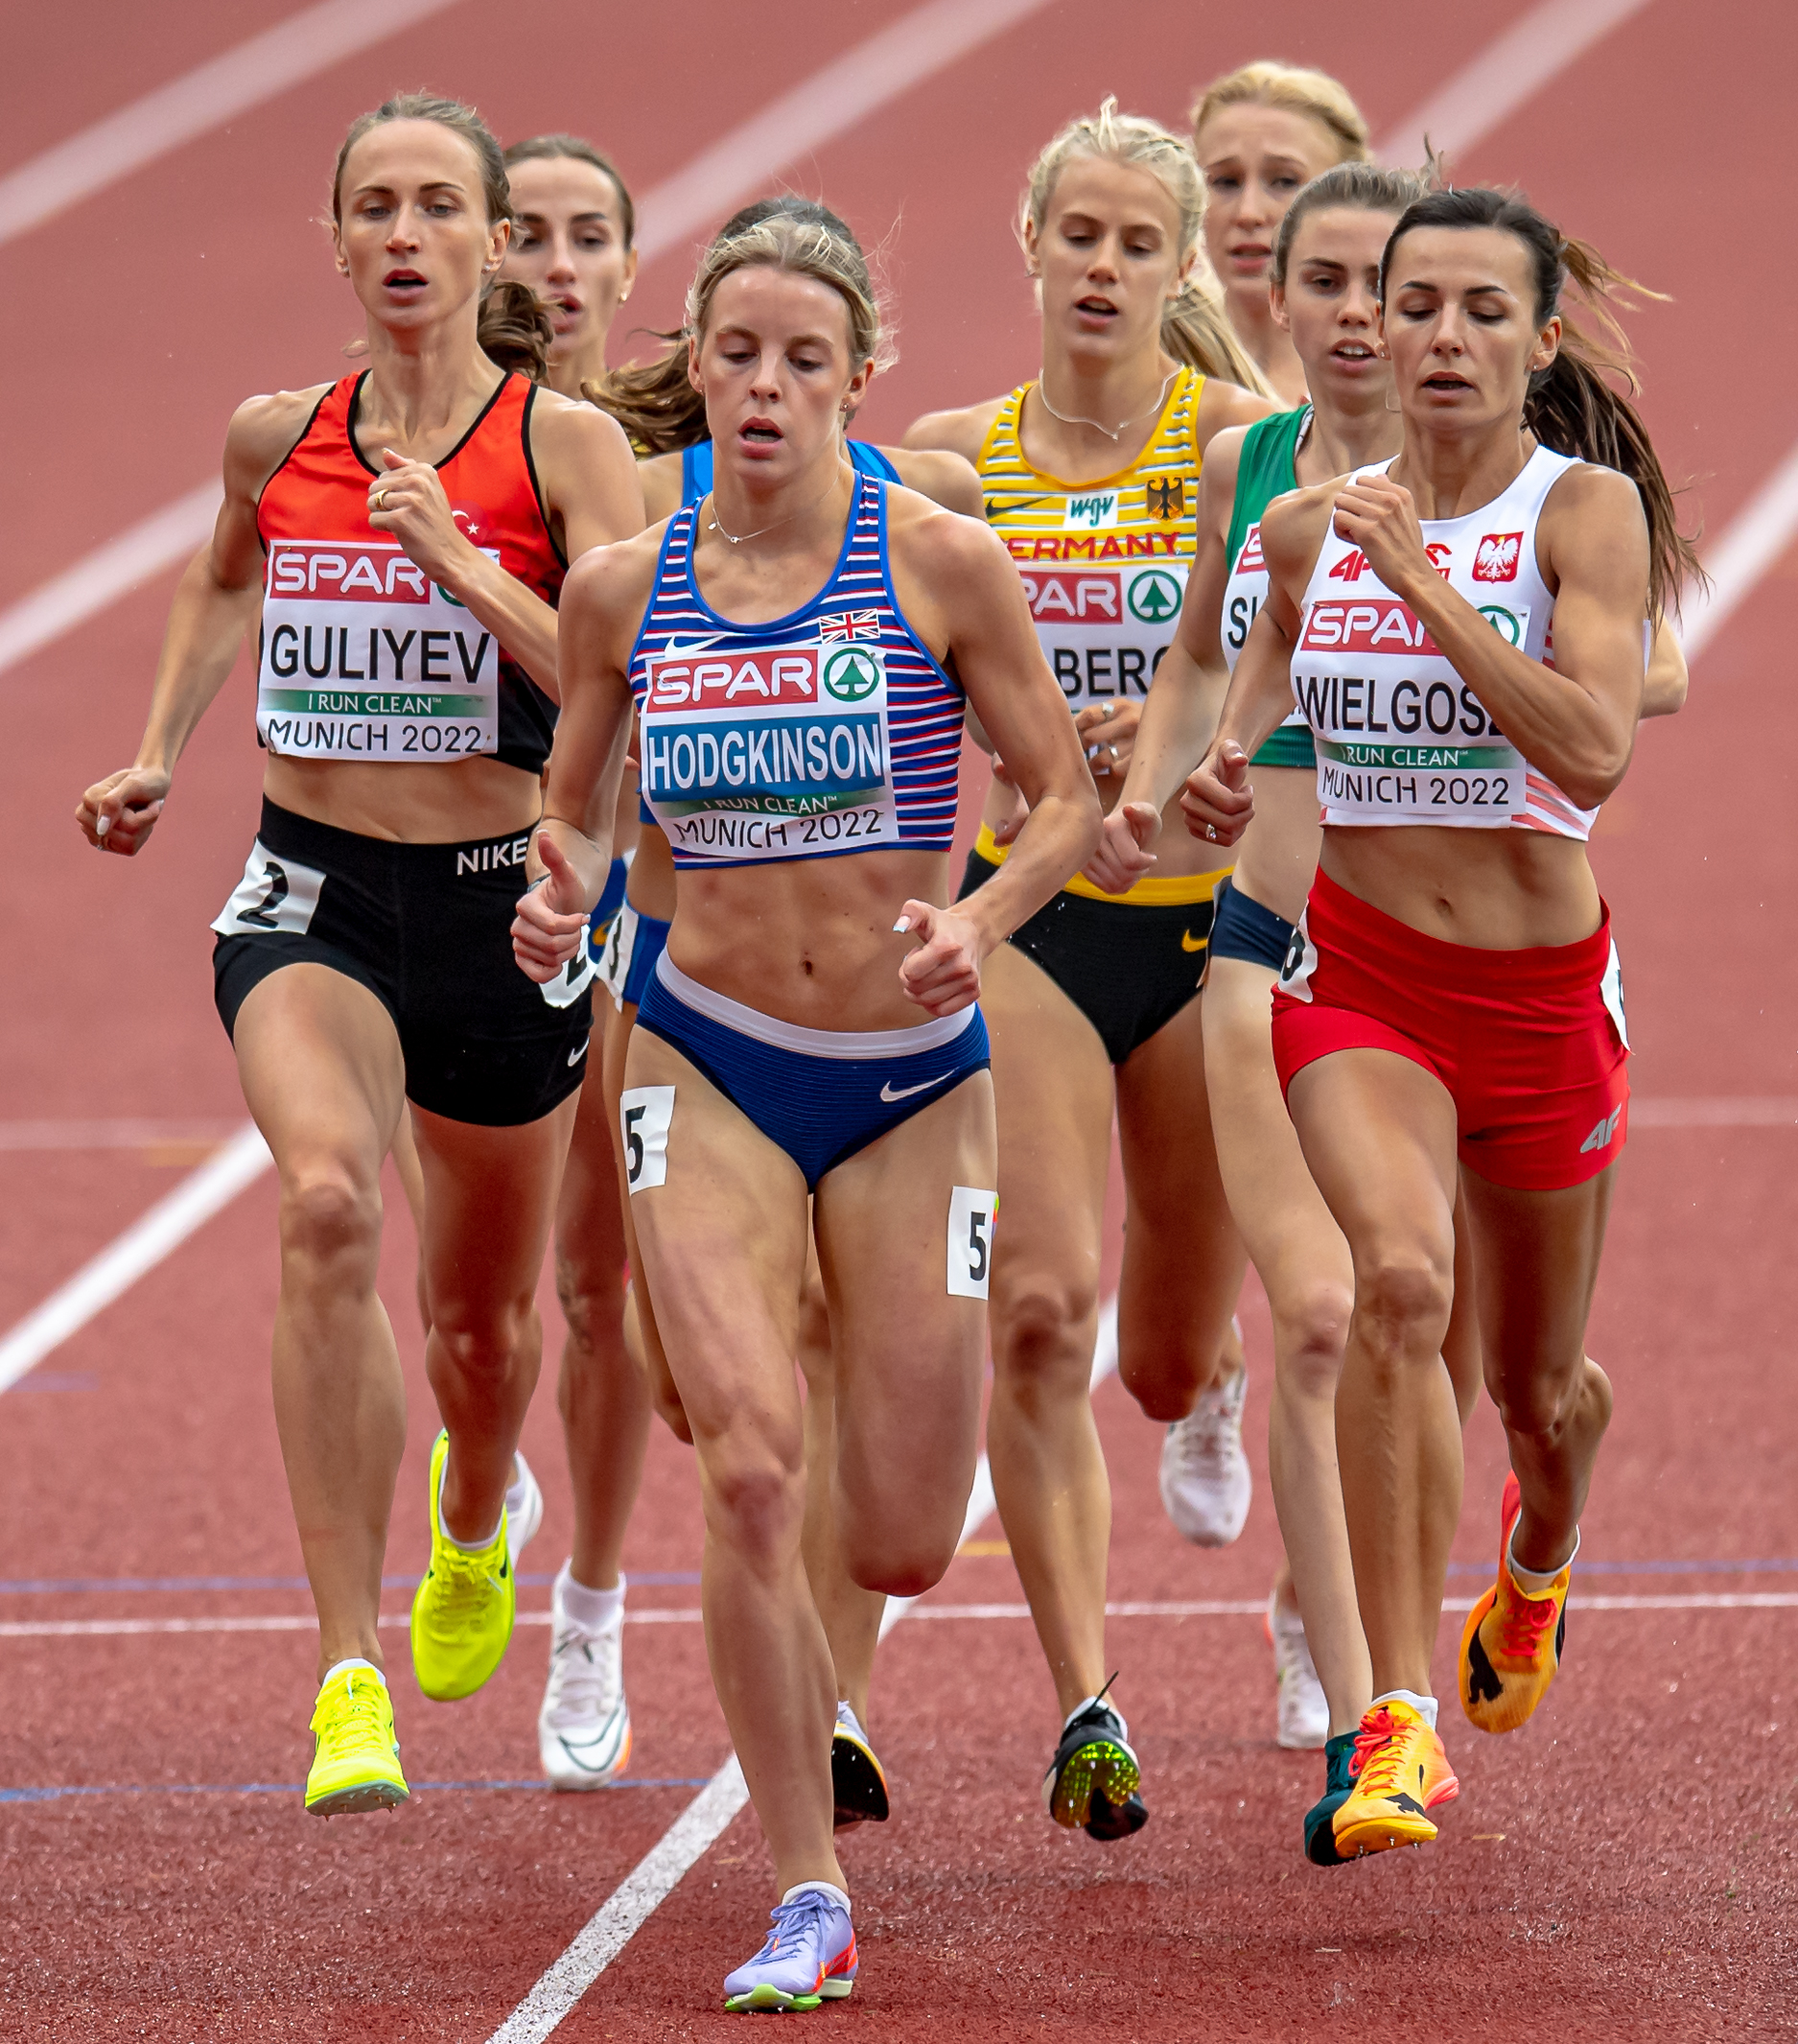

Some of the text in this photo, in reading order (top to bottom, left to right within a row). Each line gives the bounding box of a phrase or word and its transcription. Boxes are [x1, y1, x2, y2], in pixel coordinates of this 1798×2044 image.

[1070, 495, 1114, 527] wgv
[1004, 531, 1181, 562] ERMANY
[274, 552, 426, 597] SPAR
[269, 623, 491, 685] GULIYEV
[652, 657, 813, 705] SPAR
[308, 693, 313, 711] I
[317, 693, 359, 713] RUN
[1295, 675, 1506, 738] WIELGOS
[268, 717, 482, 754] MUNICH 2022
[1345, 745, 1386, 765] RUN
[648, 723, 882, 791] HODGKINSON
[703, 800, 711, 810] I
[715, 796, 760, 811] RUN
[1322, 765, 1509, 806] MUNICH 2022
[673, 809, 882, 849] MUNICH 2022
[456, 836, 528, 876] NIKE
[236, 860, 290, 929] 2
[624, 1105, 647, 1186] 5
[969, 1210, 987, 1282] 5
